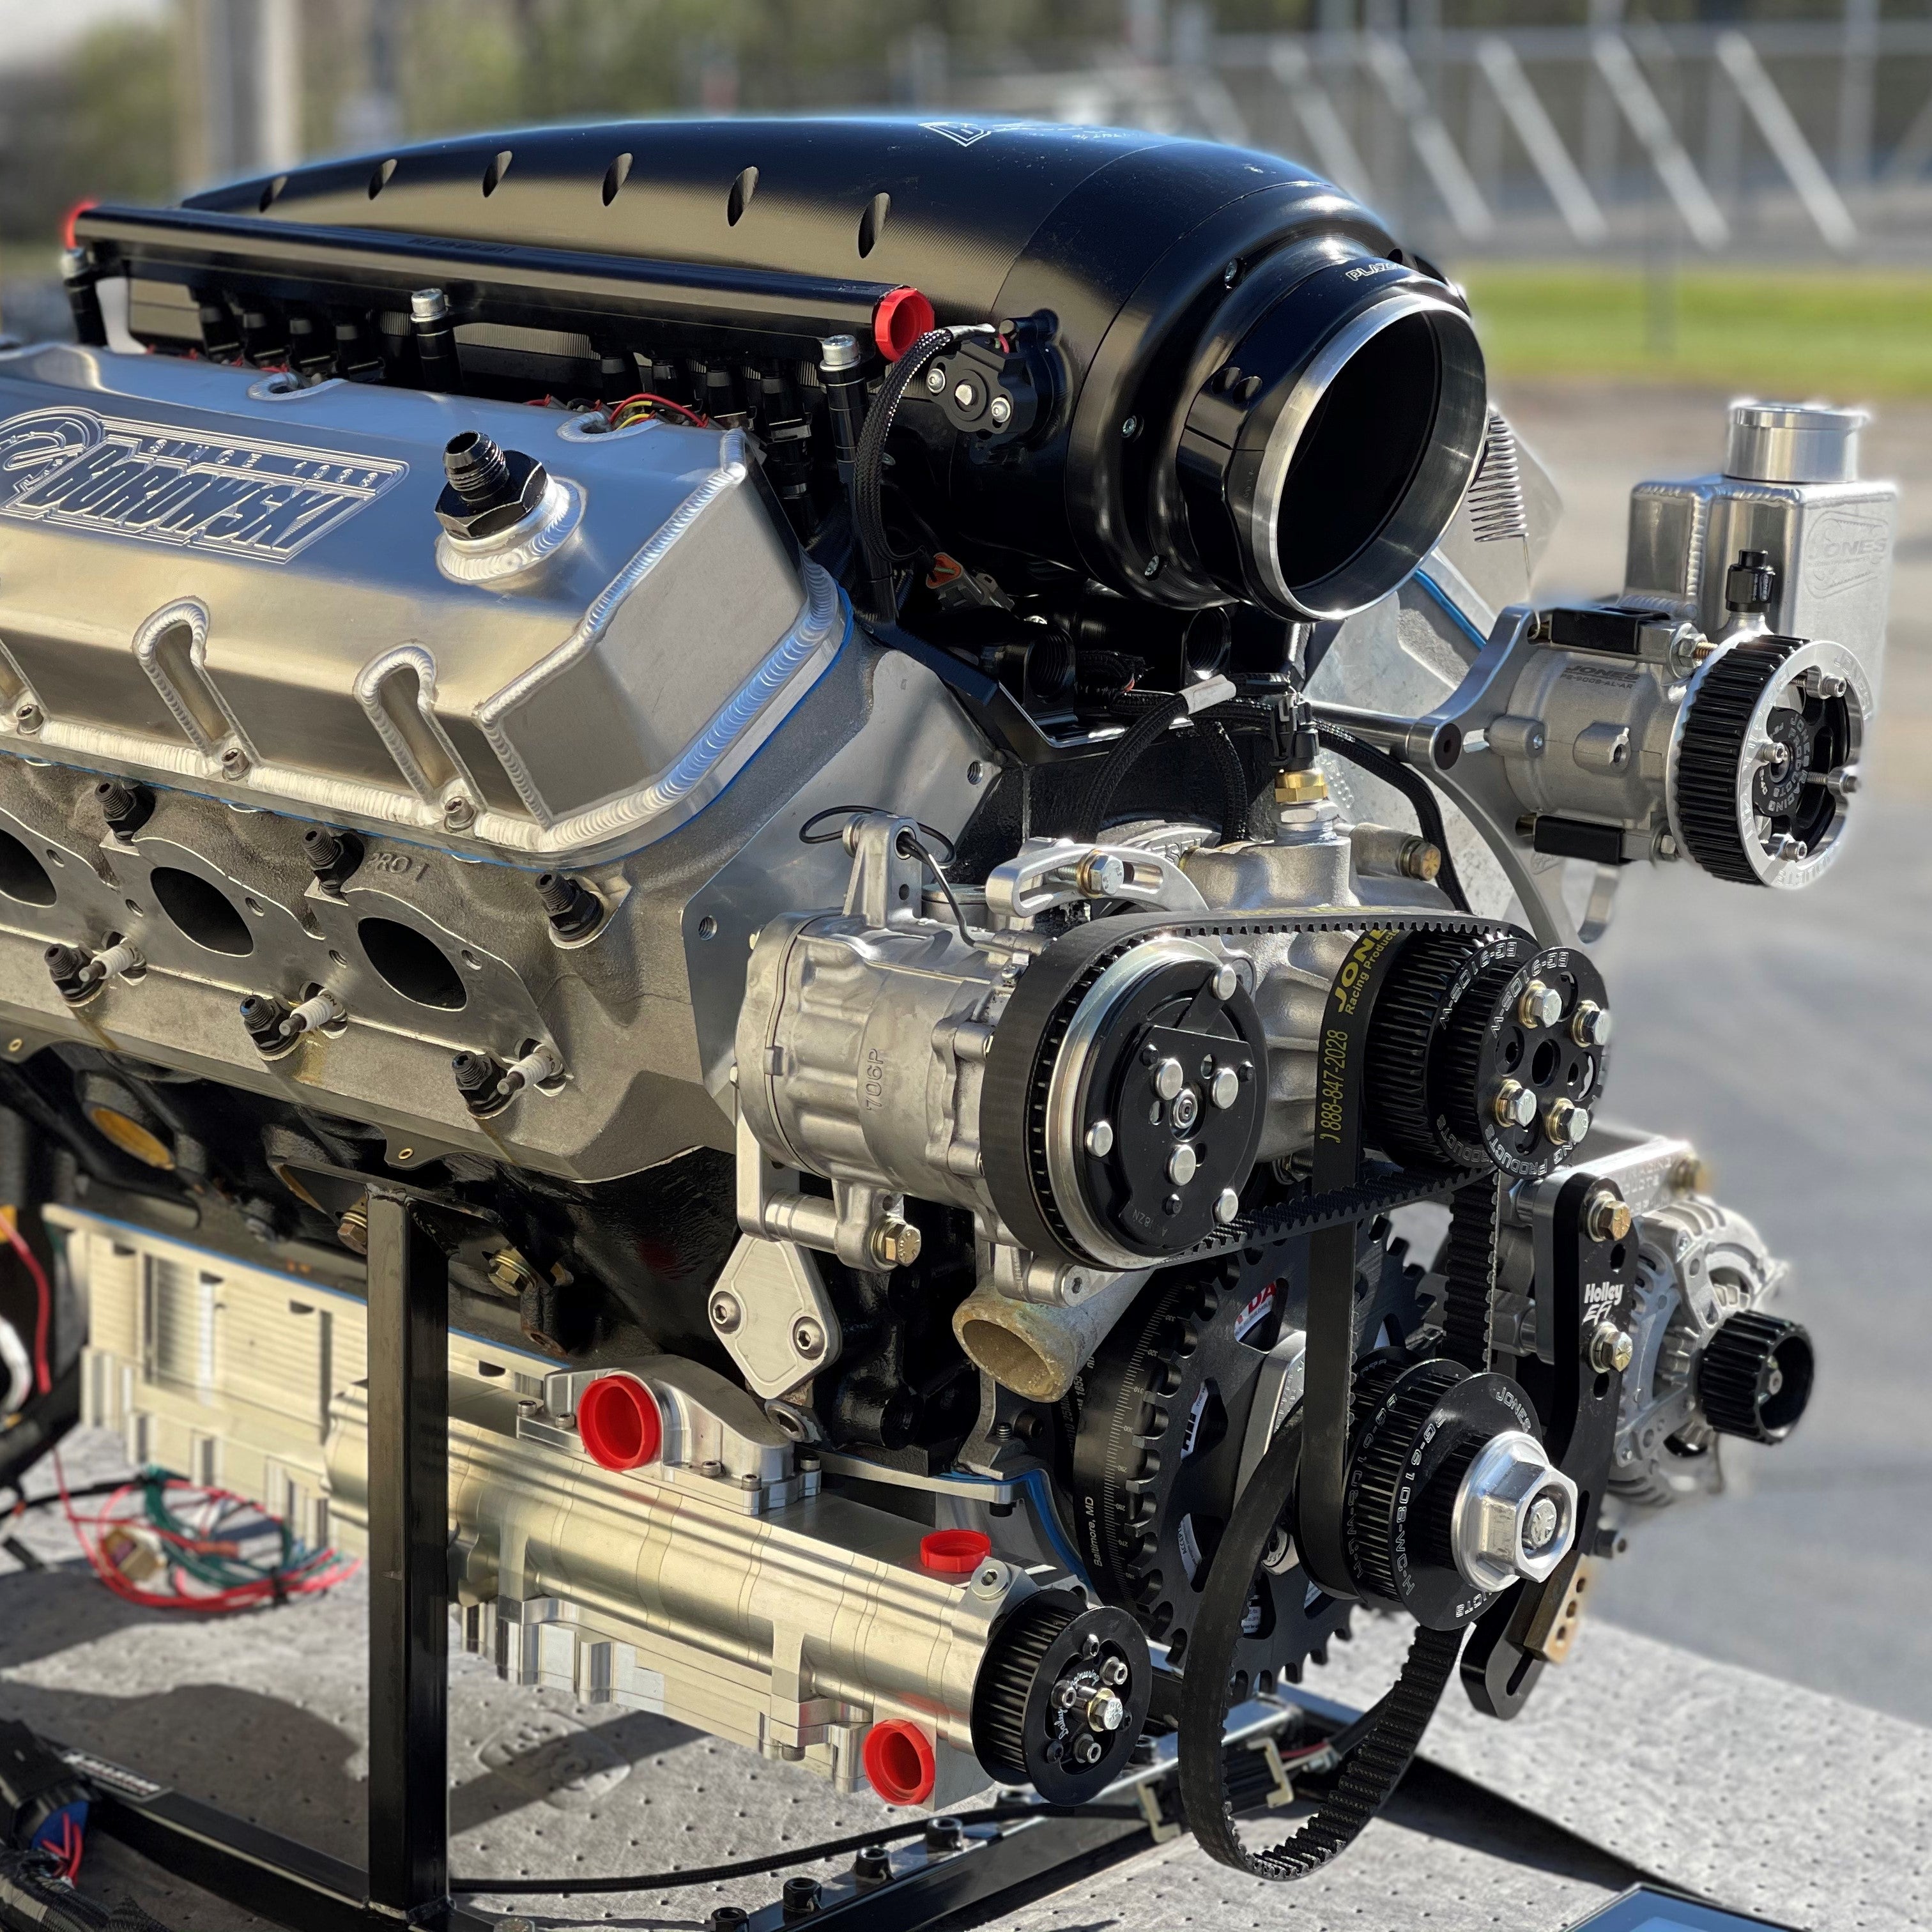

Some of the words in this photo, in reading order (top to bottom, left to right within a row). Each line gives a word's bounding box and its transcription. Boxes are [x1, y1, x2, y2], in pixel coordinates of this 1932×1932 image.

[149, 439, 262, 468] SINCE
[1565, 665, 1641, 680] JONES
[1790, 714, 1811, 767] JONES
[1768, 769, 1809, 812] RACING
[1345, 971, 1370, 1015] Racing
[866, 1048, 885, 1111] 706P
[1320, 1029, 1348, 1131] 888-847-2028
[1484, 1124, 1548, 1176] PRODUCTS
[1582, 1300, 1614, 1327] EFI
[1583, 1282, 1625, 1306] Holley
[1147, 1349, 1159, 1357] 320
[1495, 1386, 1531, 1433] JONES
[1085, 1496, 1094, 1516] MD
[1088, 1519, 1103, 1567] Baltimore,
[1118, 1539, 1128, 1547] 270
